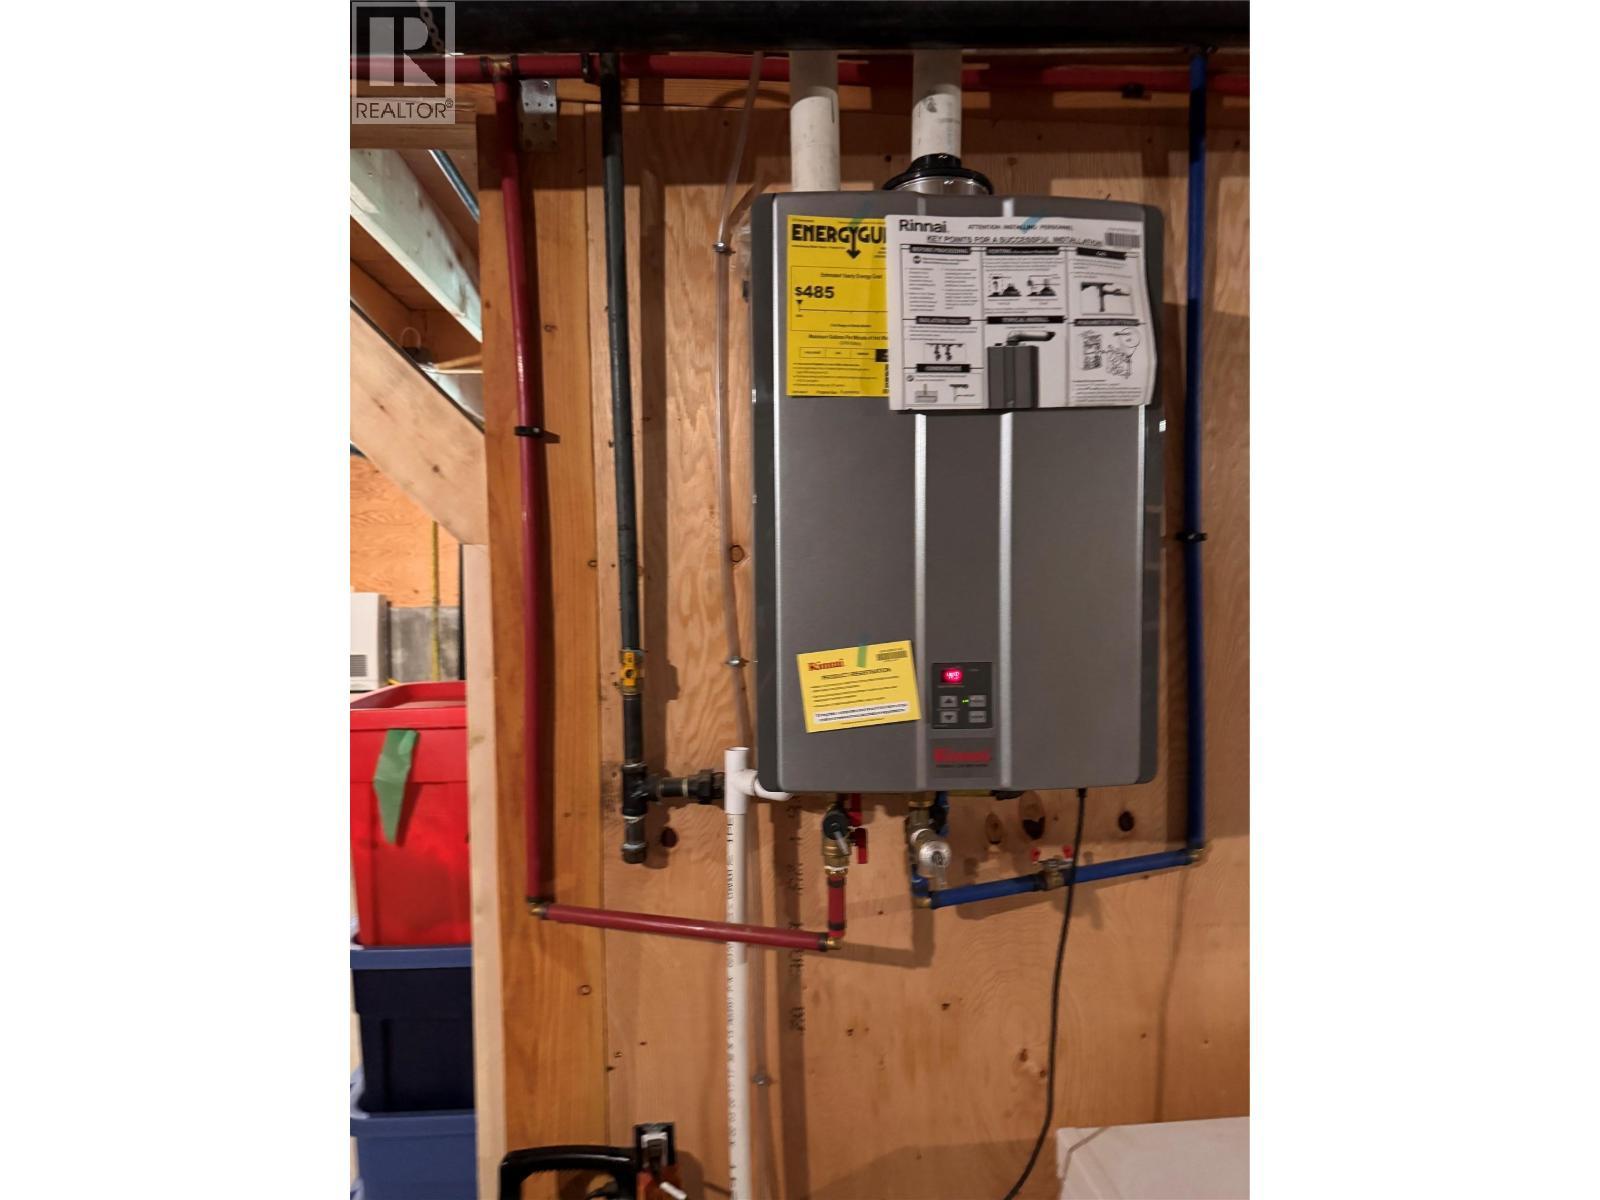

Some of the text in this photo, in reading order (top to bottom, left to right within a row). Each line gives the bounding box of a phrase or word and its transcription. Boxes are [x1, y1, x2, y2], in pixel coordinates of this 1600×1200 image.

[899, 219, 947, 233] Rinnai
[927, 236, 943, 244] KEY
[944, 236, 972, 244] POINTS
[974, 236, 991, 244] FOR
[795, 285, 835, 299] $485
